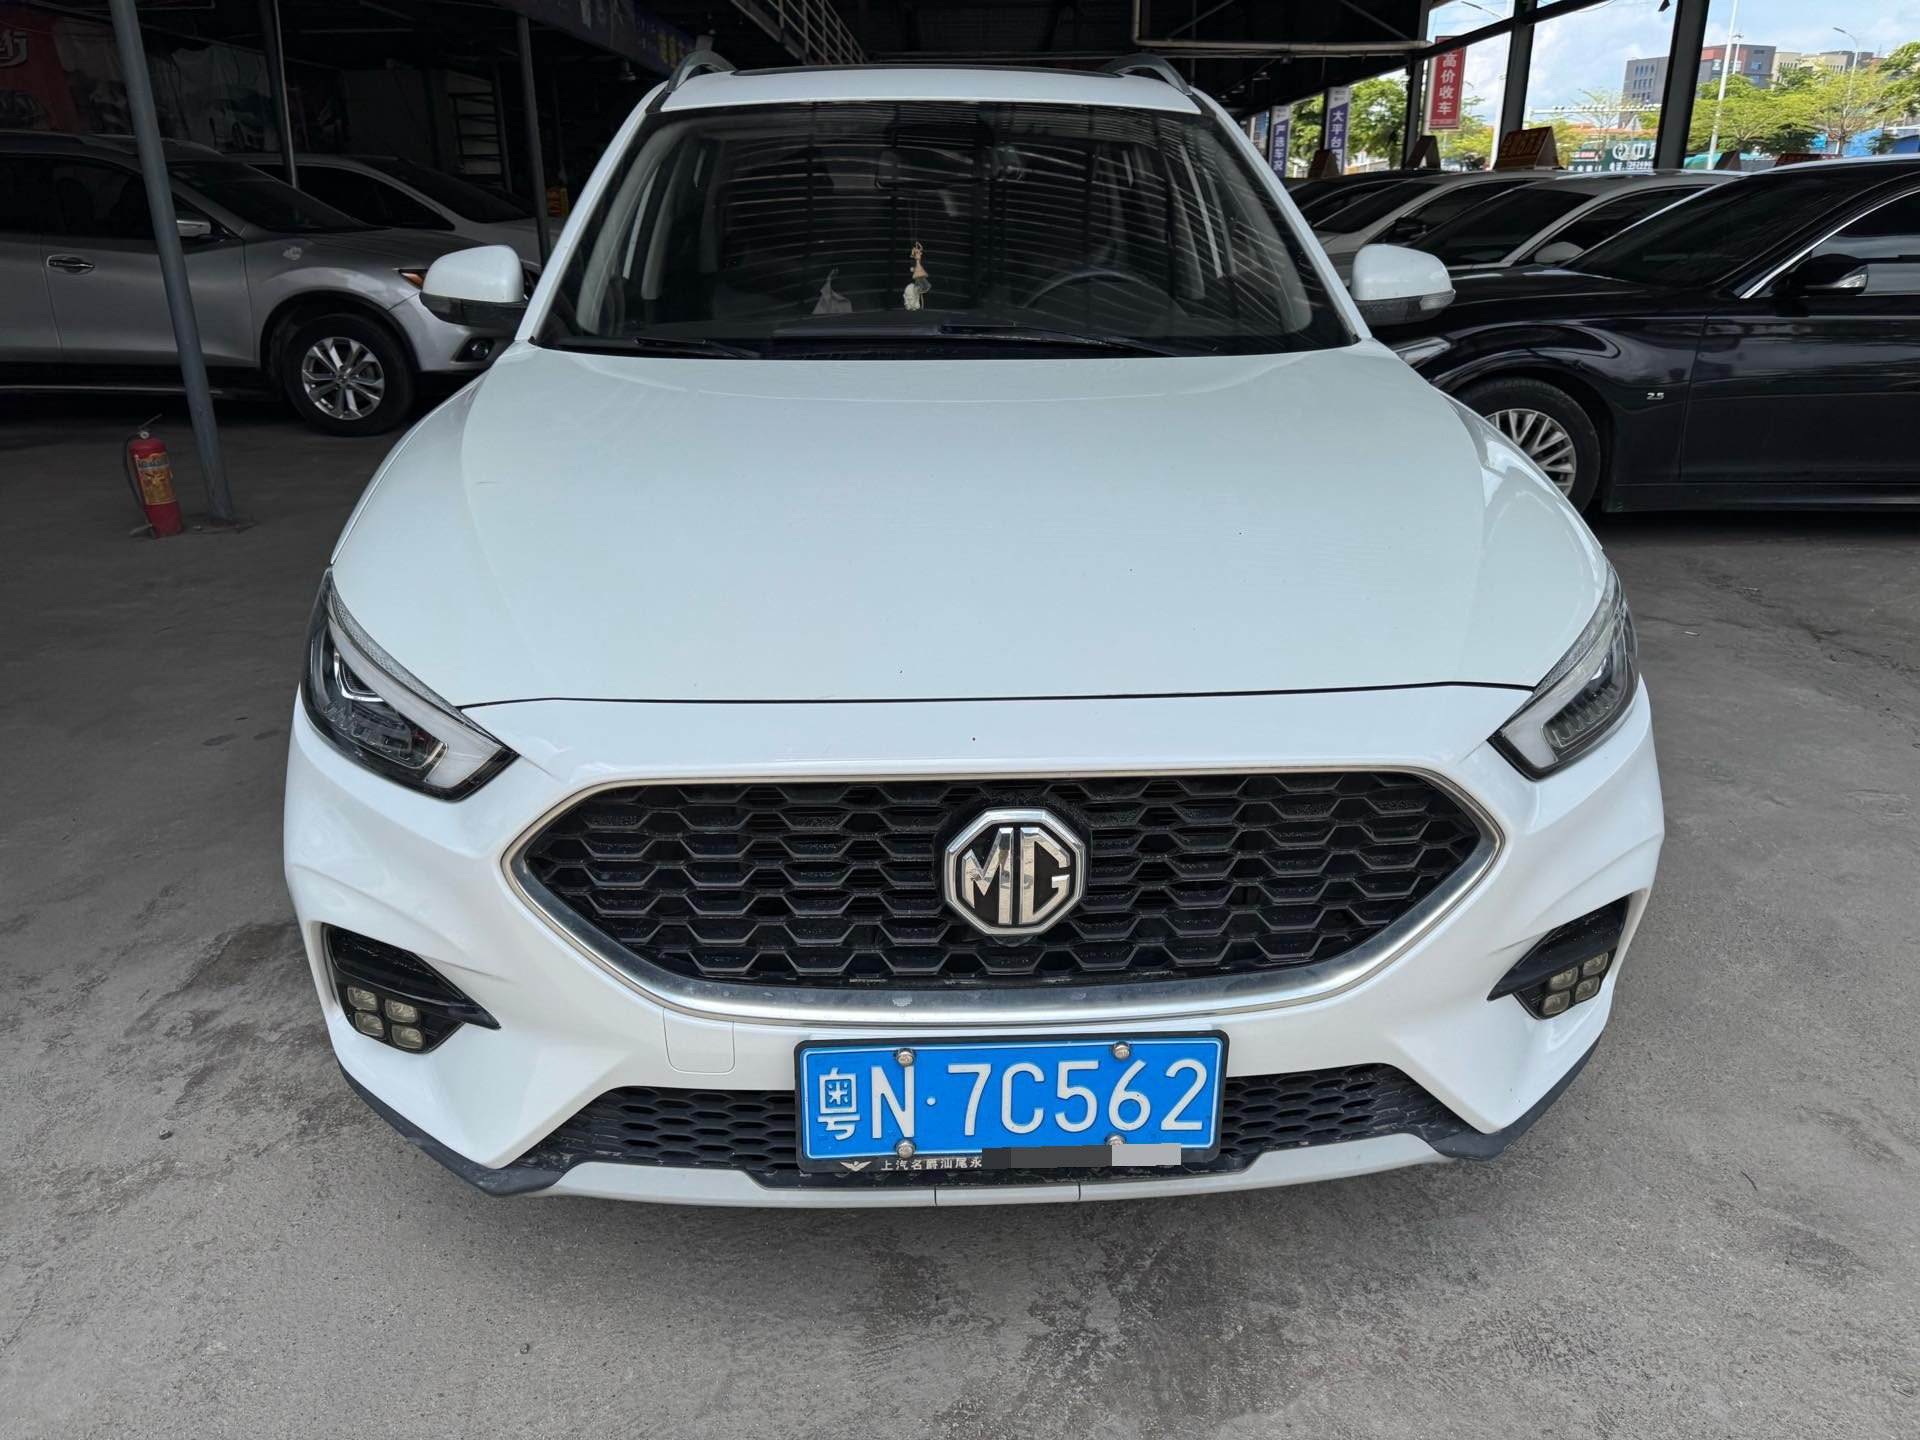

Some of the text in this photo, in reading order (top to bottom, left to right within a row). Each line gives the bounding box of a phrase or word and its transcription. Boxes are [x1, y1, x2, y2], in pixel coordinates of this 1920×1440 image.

[1437, 53, 1458, 115] 高价收车
[961, 827, 1071, 925] MG
